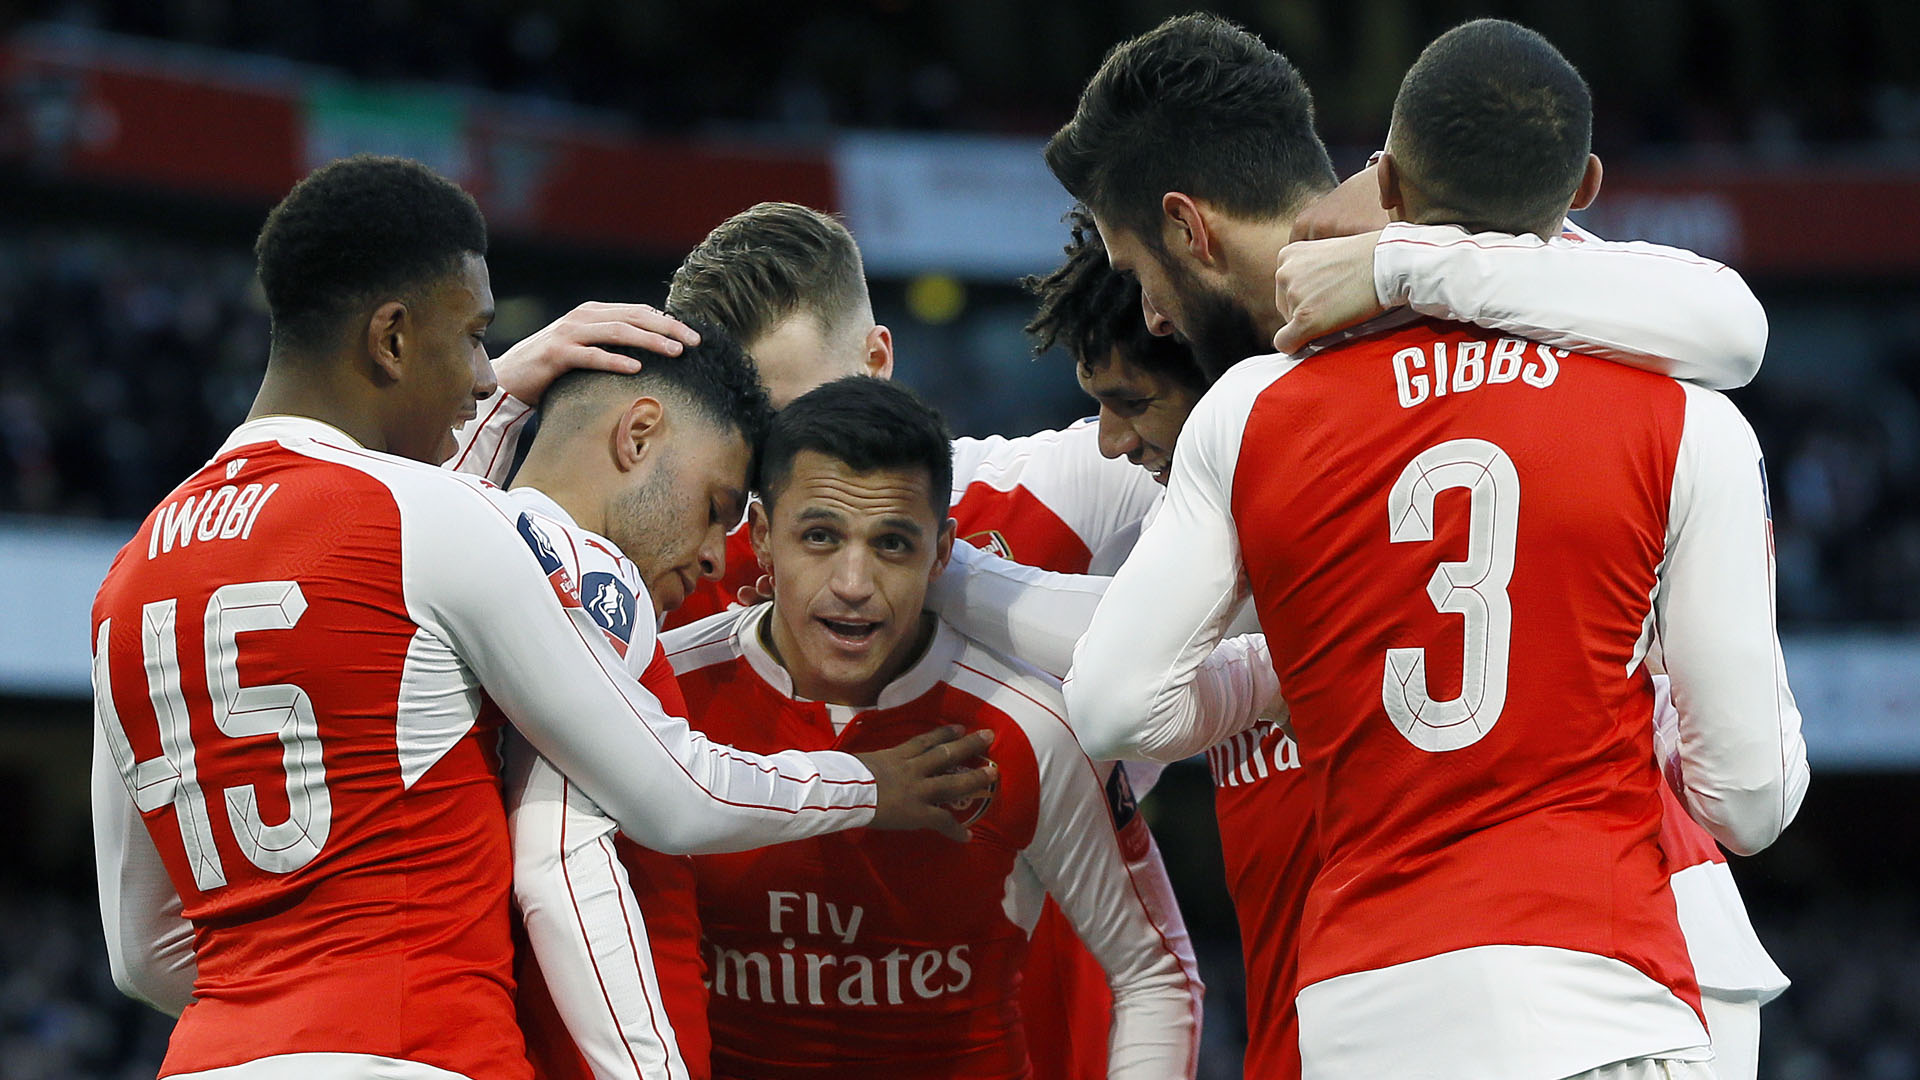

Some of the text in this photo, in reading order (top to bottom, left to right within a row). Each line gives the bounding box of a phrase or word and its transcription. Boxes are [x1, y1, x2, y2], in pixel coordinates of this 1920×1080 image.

[1392, 338, 1570, 409] GIBBS
[147, 483, 279, 560] IWOBI
[1381, 438, 1520, 752] 3
[92, 580, 332, 891] 45
[1206, 720, 1302, 788] mira
[767, 890, 864, 944] Fly
[704, 937, 973, 1006] mirates
